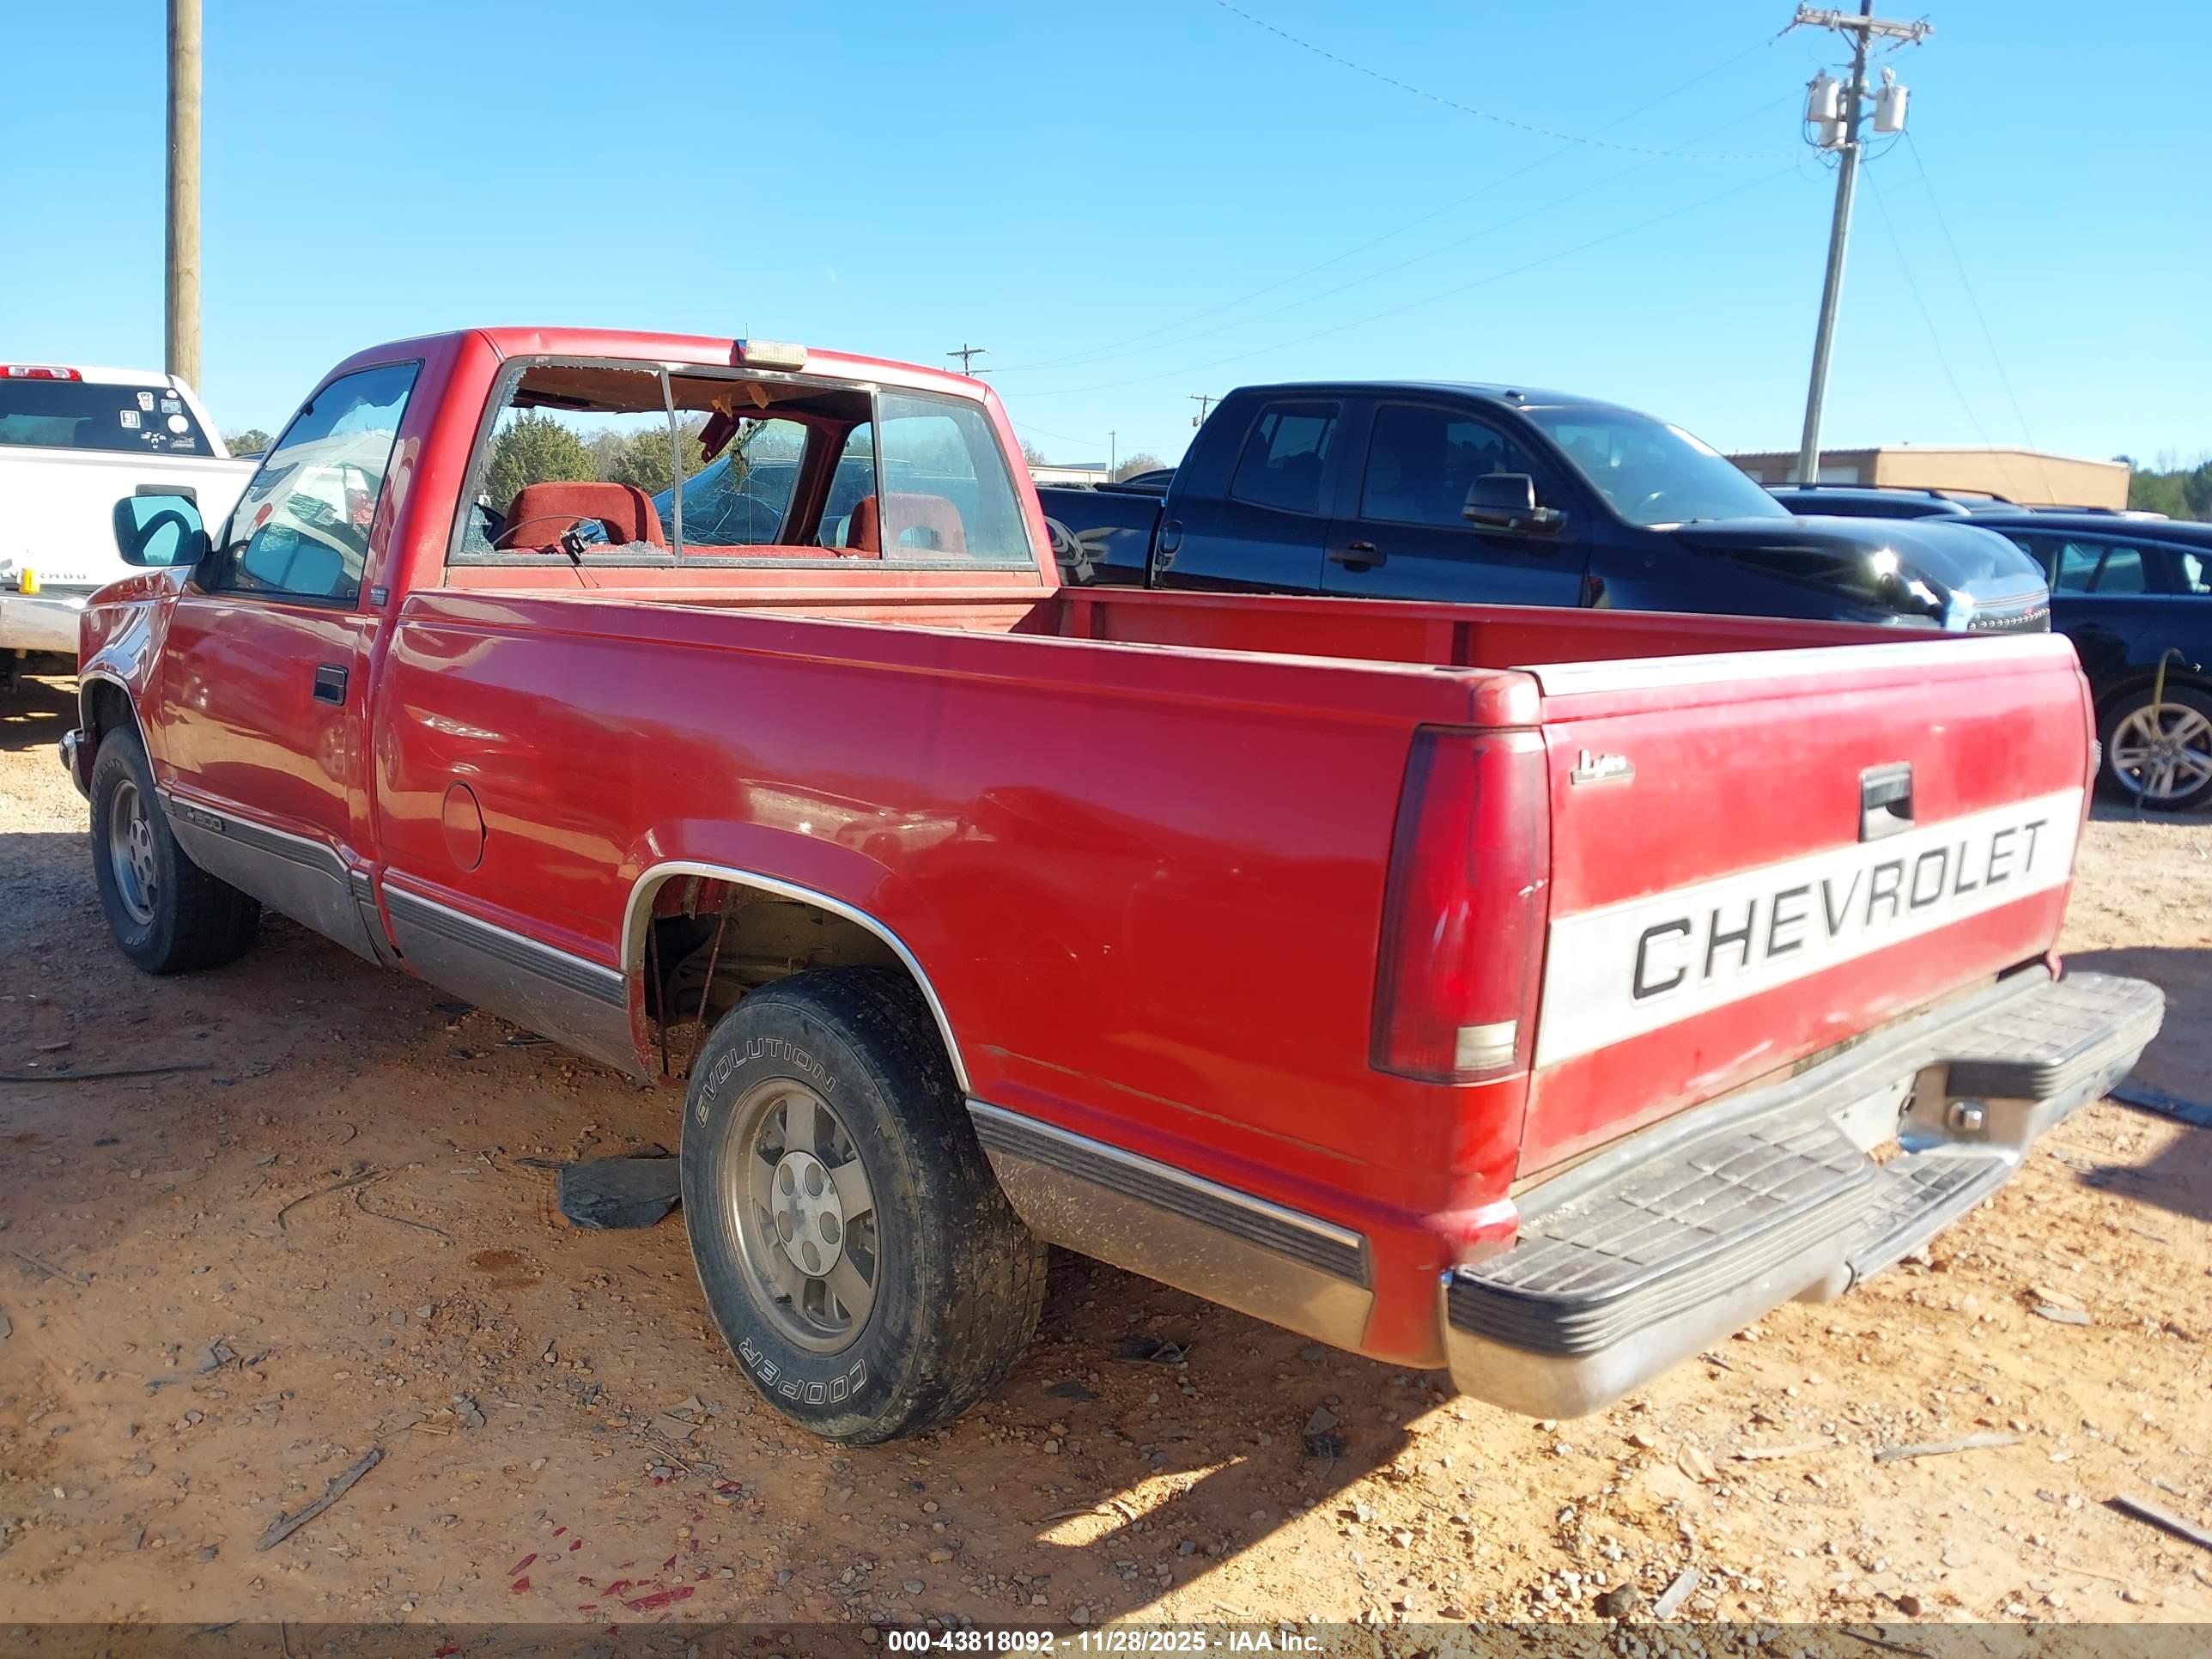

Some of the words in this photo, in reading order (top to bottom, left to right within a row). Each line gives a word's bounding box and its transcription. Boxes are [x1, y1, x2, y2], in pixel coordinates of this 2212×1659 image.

[1633, 818, 2048, 1000] CHEVROLET
[694, 1037, 838, 1129] EVOLUTION
[738, 1336, 869, 1406] COOPER
